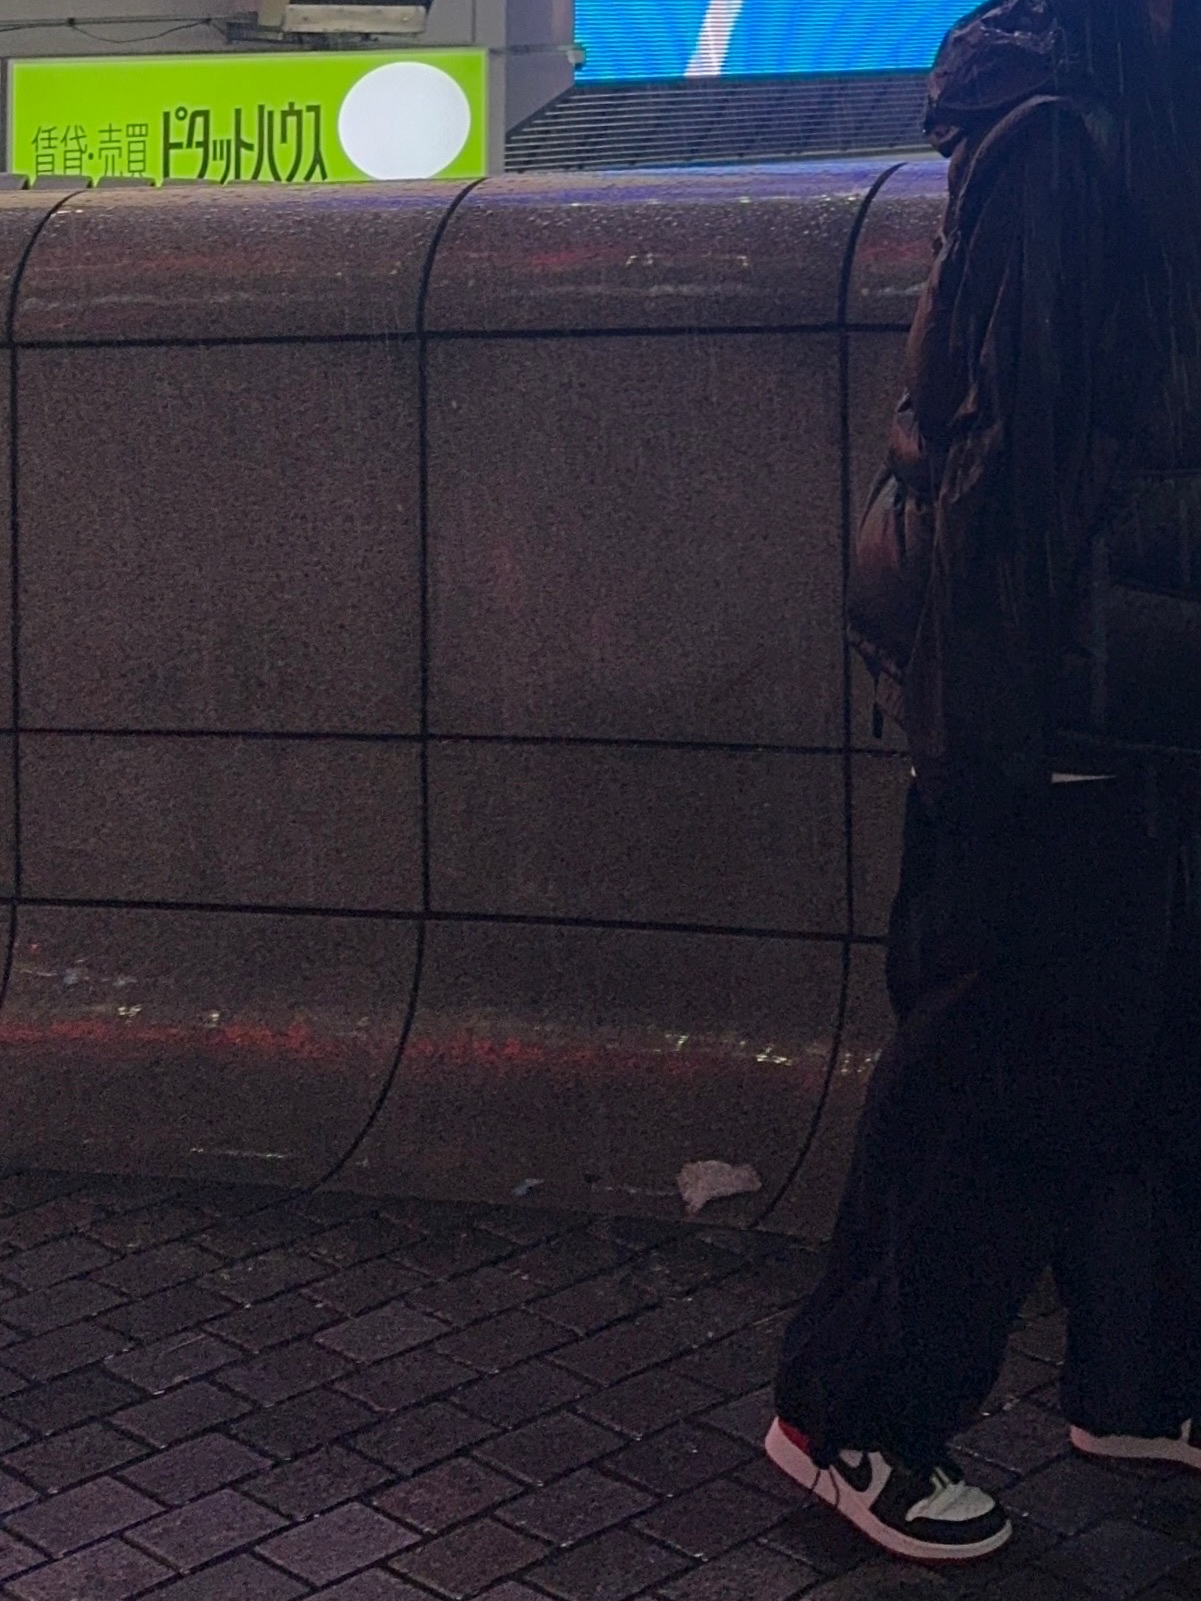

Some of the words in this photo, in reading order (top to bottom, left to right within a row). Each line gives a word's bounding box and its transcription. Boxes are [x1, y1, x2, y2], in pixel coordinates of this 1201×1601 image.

[162, 101, 328, 185] ピタットハウス
